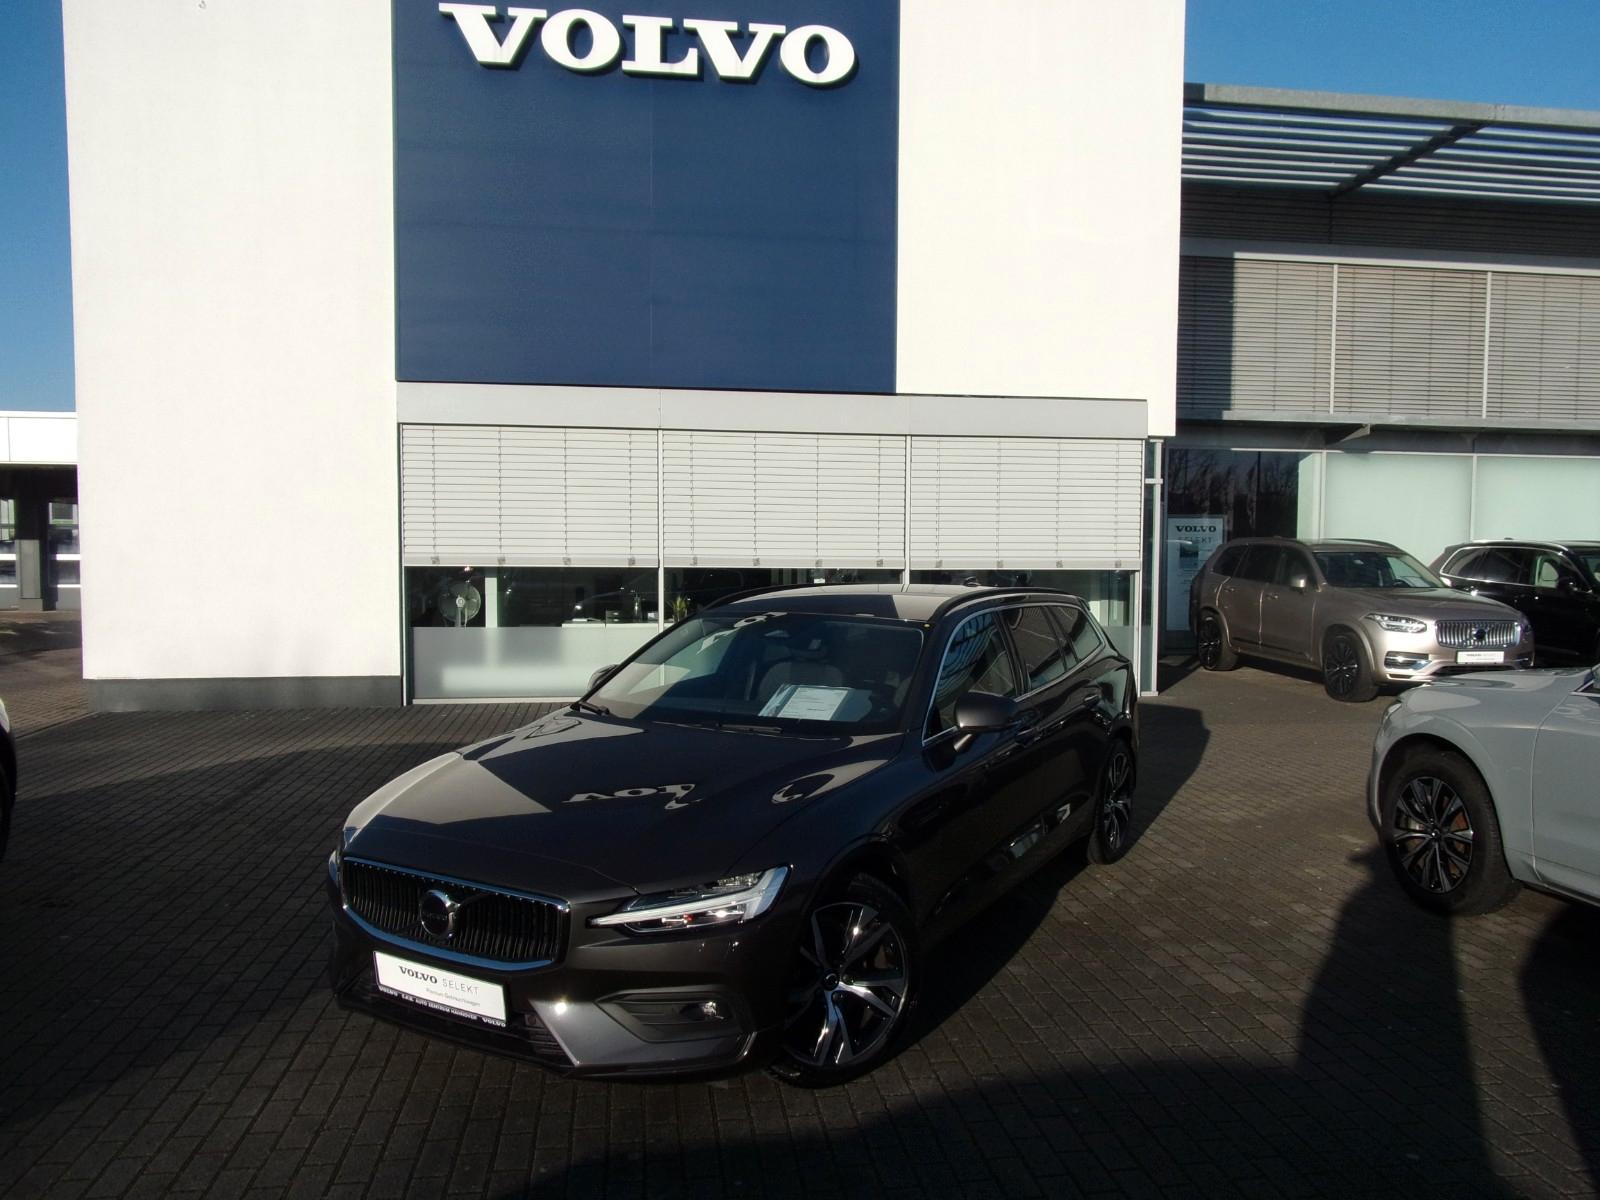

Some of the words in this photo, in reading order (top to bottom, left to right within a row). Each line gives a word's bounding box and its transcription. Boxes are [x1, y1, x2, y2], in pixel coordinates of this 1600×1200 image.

[438, 2, 857, 85] VOLVO
[1175, 525, 1217, 533] VOLVO
[398, 965, 438, 984] VOLVO
[442, 978, 480, 996] SELEKT
[481, 1016, 506, 1028] VOLVO
